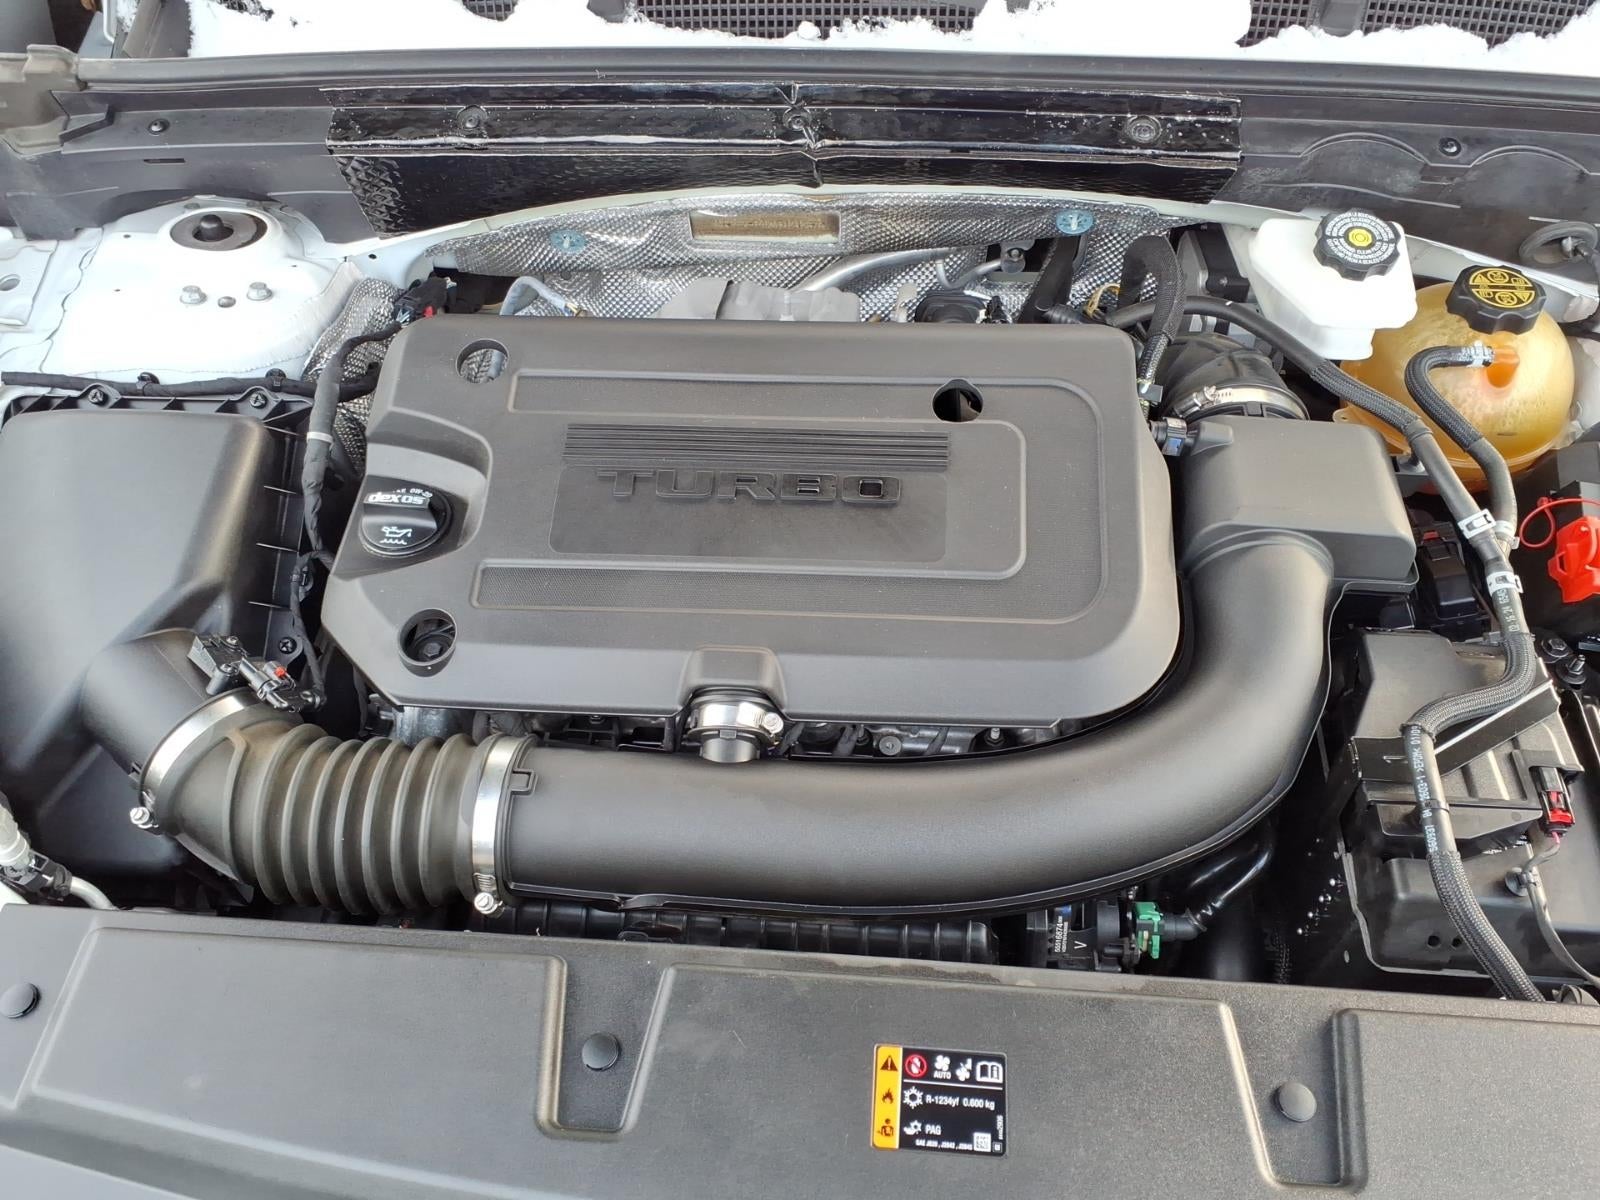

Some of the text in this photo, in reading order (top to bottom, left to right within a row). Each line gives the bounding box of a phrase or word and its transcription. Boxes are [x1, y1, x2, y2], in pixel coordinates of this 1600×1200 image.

[597, 470, 901, 503] TURBO
[369, 492, 424, 505] dexos
[934, 1071, 951, 1080] AUTO
[926, 1095, 995, 1111] R-1234yf 0.600 kg
[926, 1125, 941, 1135] PAG
